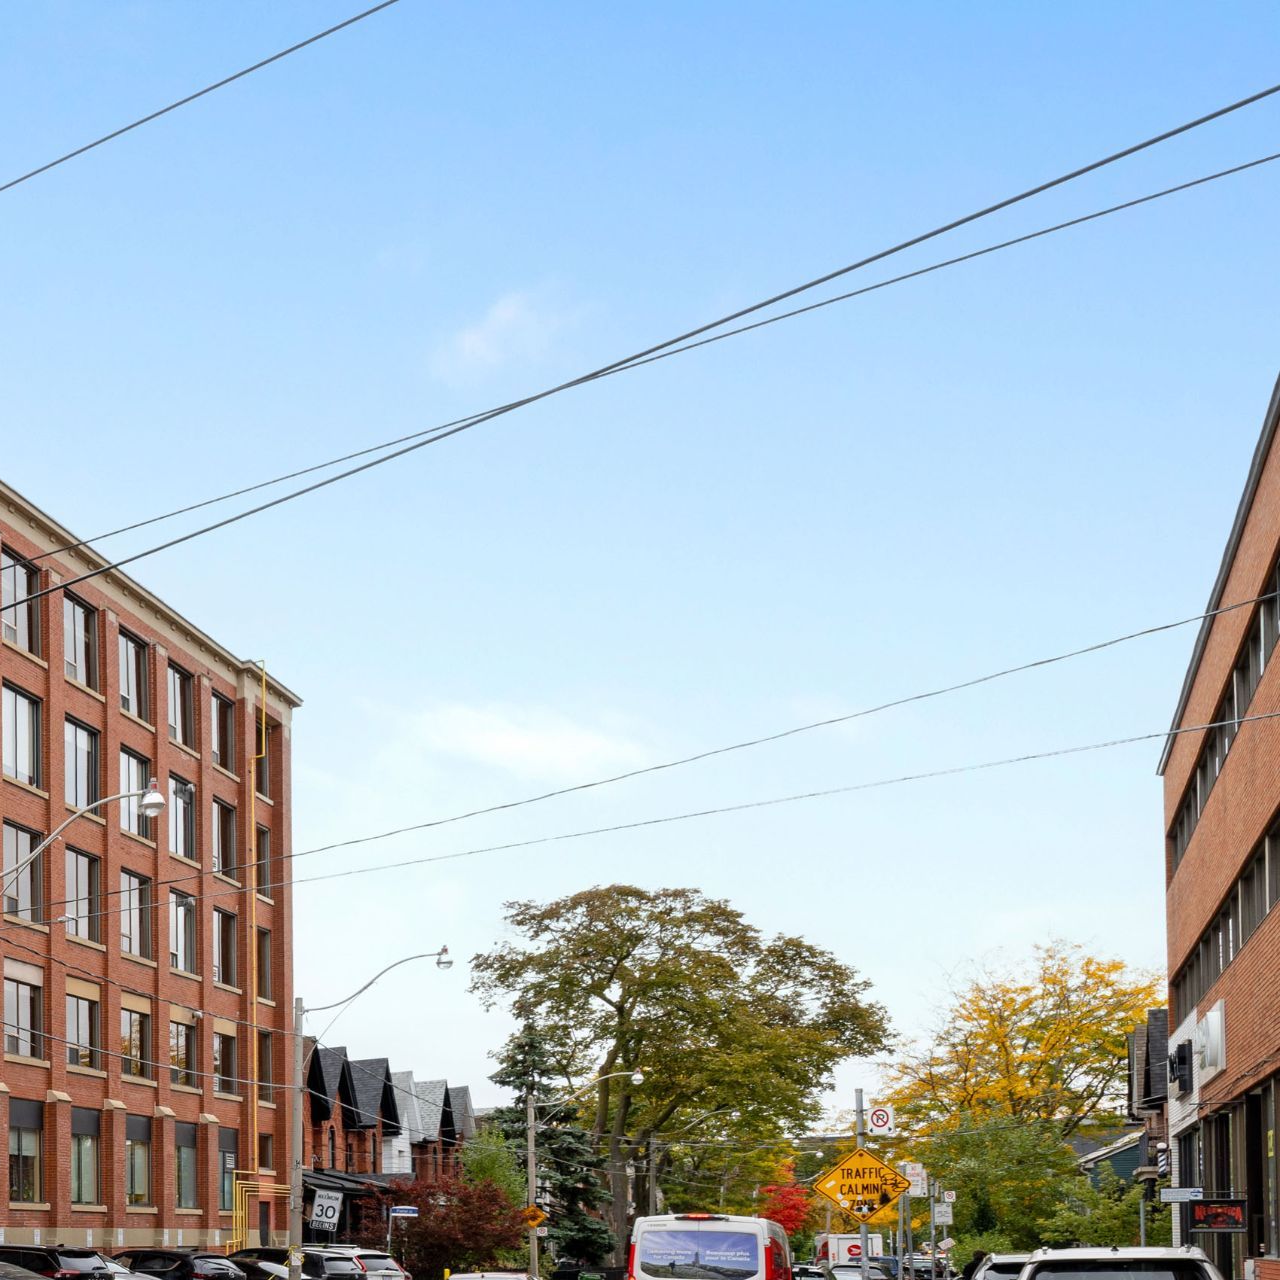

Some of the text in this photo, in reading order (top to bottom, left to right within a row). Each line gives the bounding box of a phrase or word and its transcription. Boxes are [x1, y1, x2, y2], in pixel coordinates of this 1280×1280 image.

[840, 1167, 885, 1180] TRAFFIC
[840, 1183, 886, 1196] CALMING
[315, 1204, 336, 1219] 30
[313, 1221, 334, 1230] BEGINS
